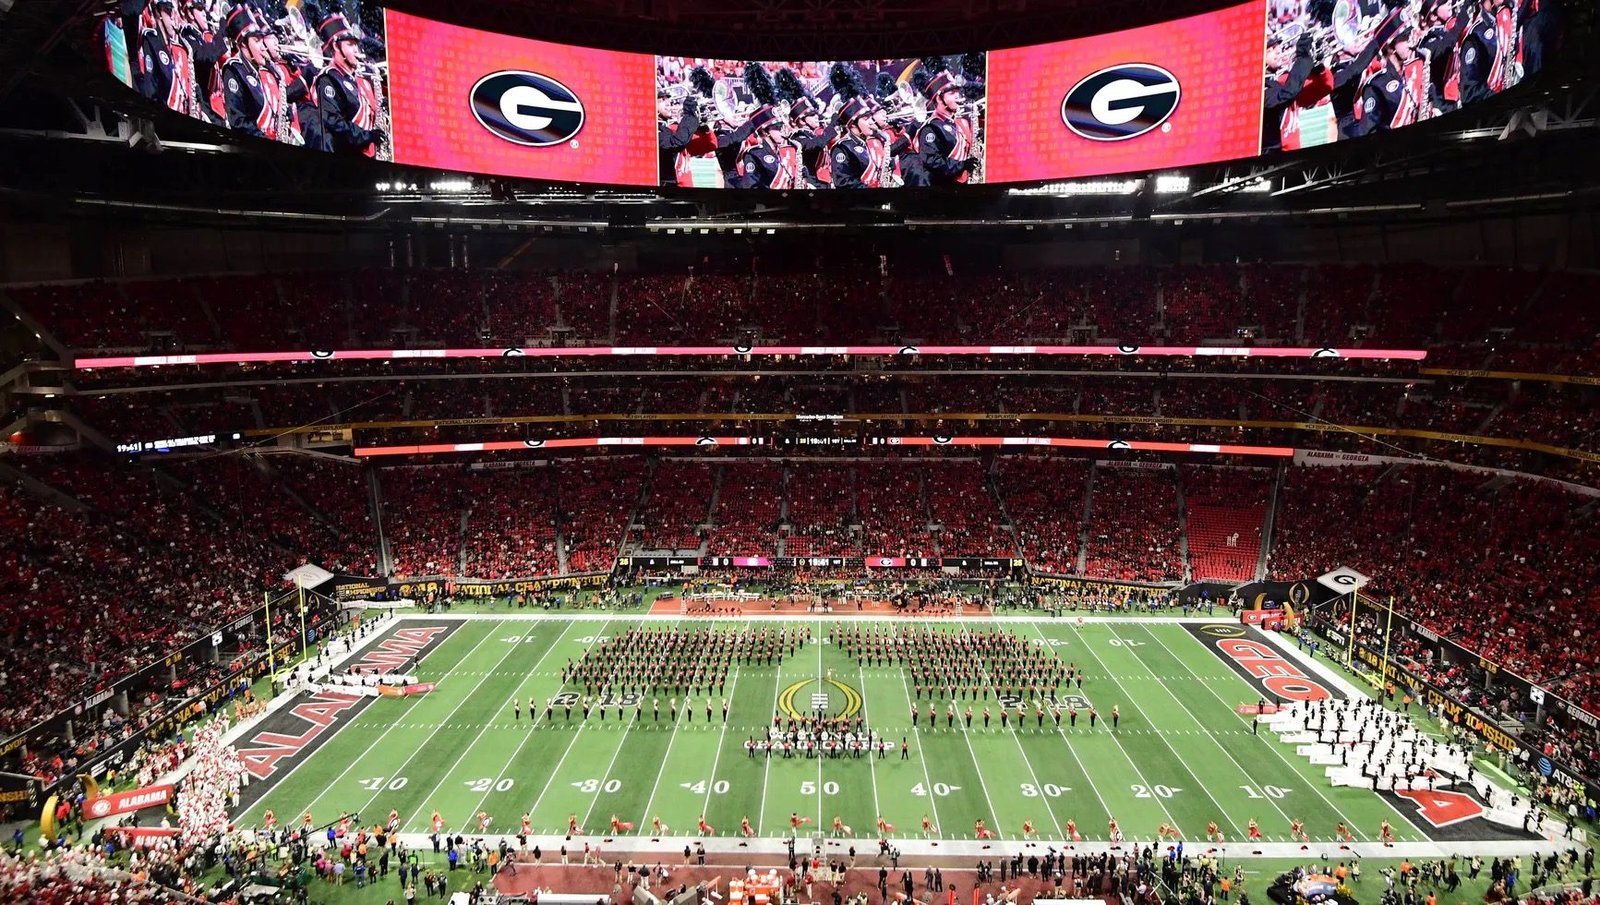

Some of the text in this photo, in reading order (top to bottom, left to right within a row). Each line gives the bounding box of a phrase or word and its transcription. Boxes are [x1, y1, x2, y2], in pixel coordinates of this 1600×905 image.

[1307, 451, 1334, 459] ALABAMA
[1342, 453, 1369, 462] GEORGIA
[453, 583, 510, 595] NATIOAL
[1479, 659, 1497, 674] 218
[238, 626, 448, 781] ALAAMA
[551, 692, 641, 707] 218
[999, 695, 1091, 710] 218
[1427, 689, 1517, 751] CHAMIONSHIP
[1566, 705, 1598, 728] GEORGIA
[769, 728, 868, 741] AIONAL
[364, 777, 408, 790] 10
[474, 778, 514, 792] 20
[580, 779, 621, 793] 30
[1552, 768, 1581, 789] AT&
[689, 779, 730, 794] 40
[800, 781, 839, 795] 50
[911, 781, 950, 796] 40
[1020, 783, 1061, 797] 30
[1130, 783, 1173, 798] 20
[1239, 784, 1285, 798] 10
[118, 790, 167, 810] ALABAMA
[135, 835, 173, 847] ALABA
